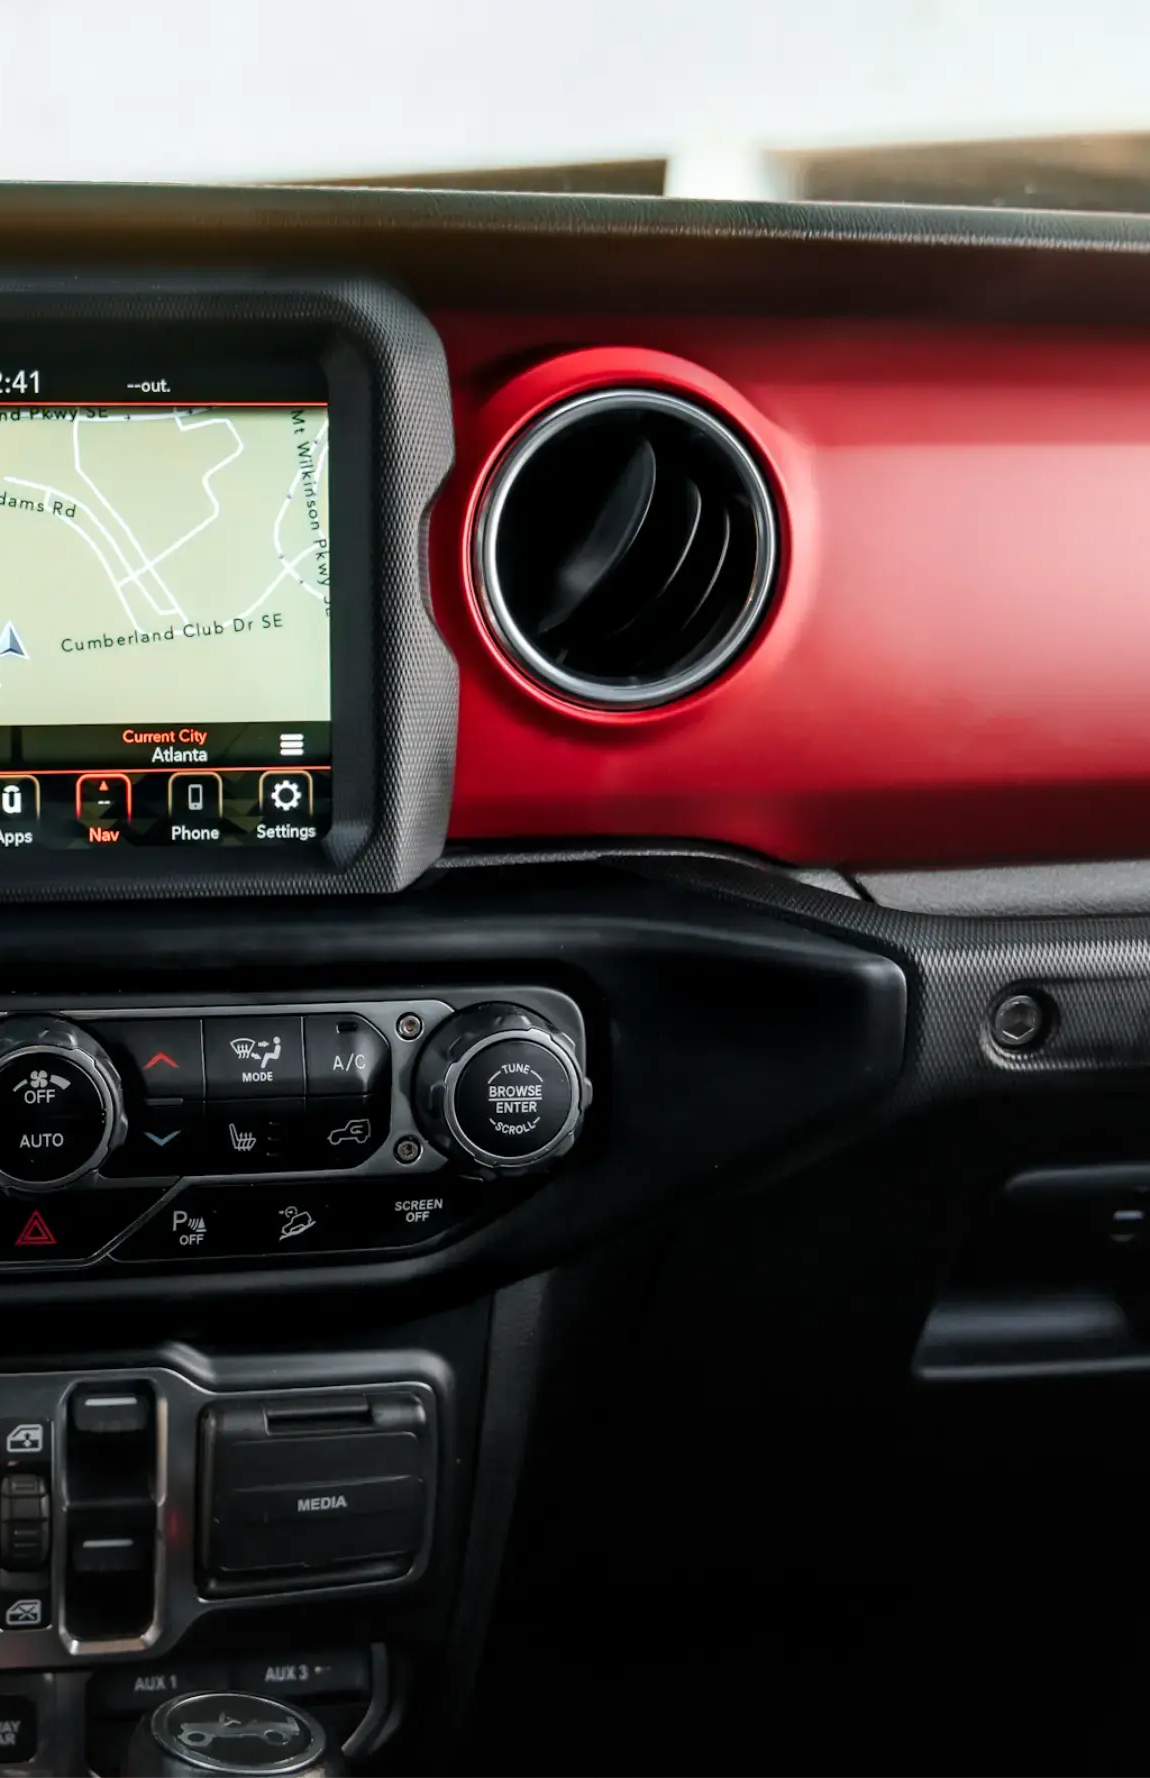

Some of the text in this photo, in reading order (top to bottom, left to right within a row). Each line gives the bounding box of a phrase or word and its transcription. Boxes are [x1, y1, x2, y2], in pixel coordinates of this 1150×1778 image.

[30, 408, 77, 422] Pkwy
[86, 408, 108, 419] SE
[290, 410, 306, 435] Mt
[297, 441, 320, 531] Wilkinson
[53, 500, 76, 518] Rd
[313, 539, 330, 587] Pkwy
[61, 613, 283, 653] Cumberland Club Dr SE
[122, 728, 207, 745] Current City
[152, 747, 208, 763] Atlanta
[89, 827, 120, 842] Nav
[171, 825, 220, 840] Phone
[256, 823, 316, 842] Settings
[333, 1053, 366, 1071] A/C
[501, 1063, 531, 1074] TUNE
[242, 1072, 273, 1082] MODE
[24, 1089, 56, 1104] OFF
[489, 1085, 542, 1097] BROWSE
[496, 1101, 537, 1113] ENTER
[494, 1121, 536, 1135] SCROLL
[19, 1133, 64, 1148] AUTO
[394, 1199, 443, 1211] SCREEN
[405, 1211, 430, 1222] OFF
[179, 1234, 204, 1246] OFF
[297, 1495, 348, 1512] MEDIA
[265, 1665, 309, 1682] AUX 3
[134, 1676, 166, 1691] AUX
